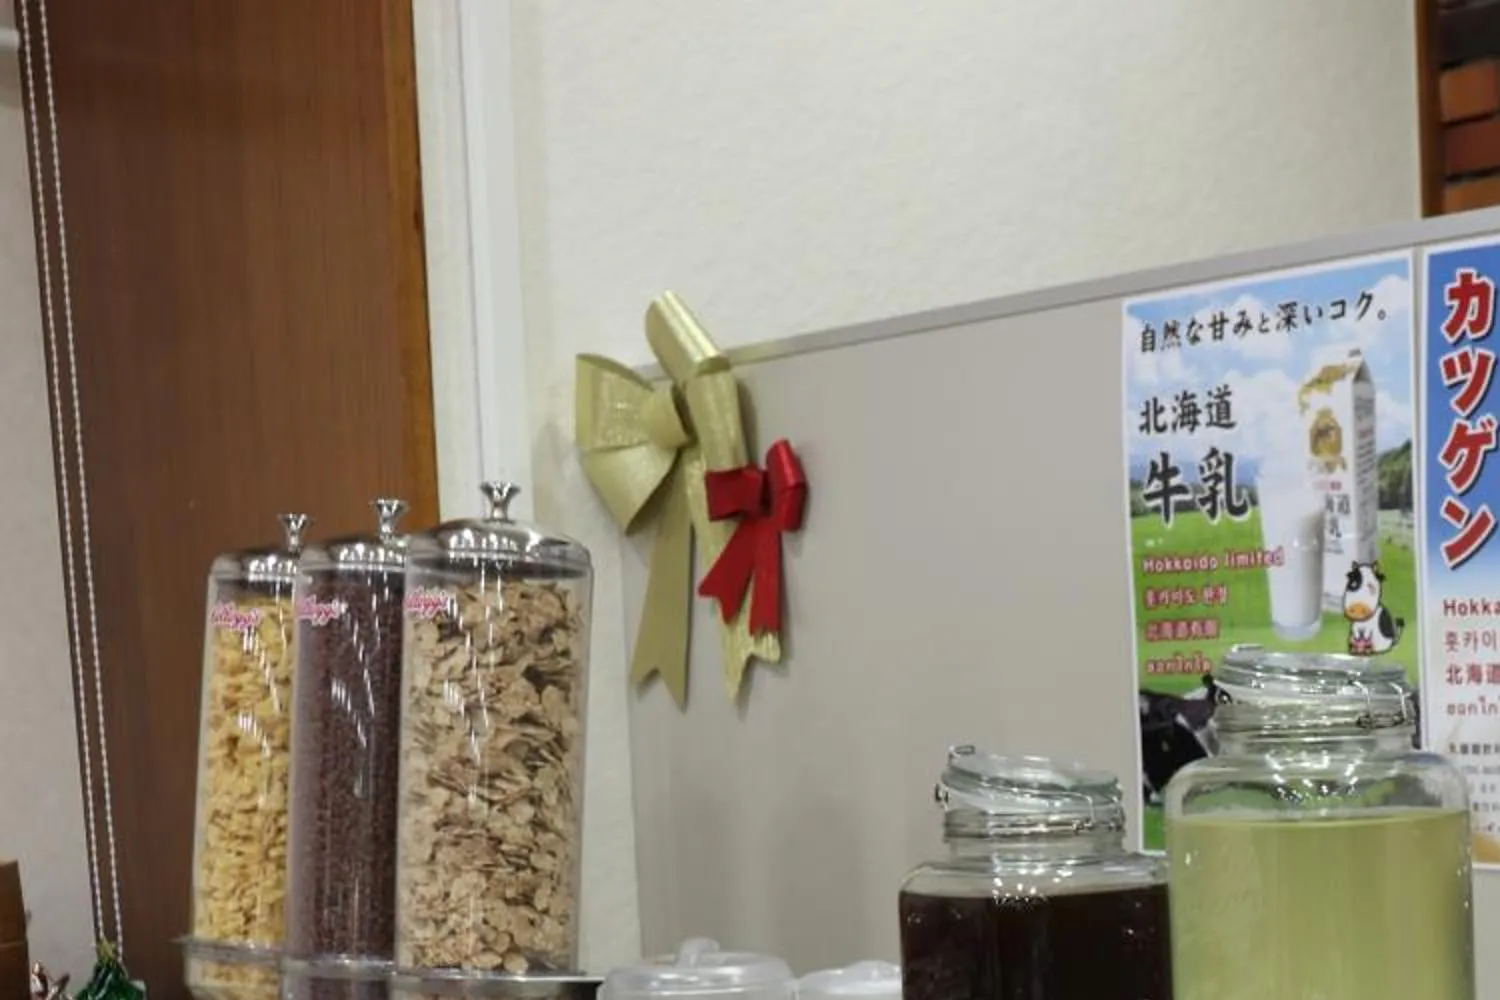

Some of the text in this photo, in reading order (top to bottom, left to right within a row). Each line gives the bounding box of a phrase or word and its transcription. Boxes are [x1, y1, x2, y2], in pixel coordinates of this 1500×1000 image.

[1140, 290, 1386, 353] 自然な甘みと深いコク。
[1139, 384, 1237, 436] 北海道
[1441, 267, 1497, 568] カツゲン
[1142, 446, 1249, 524] 牛乳
[1142, 547, 1285, 573] Hokkaido limited
